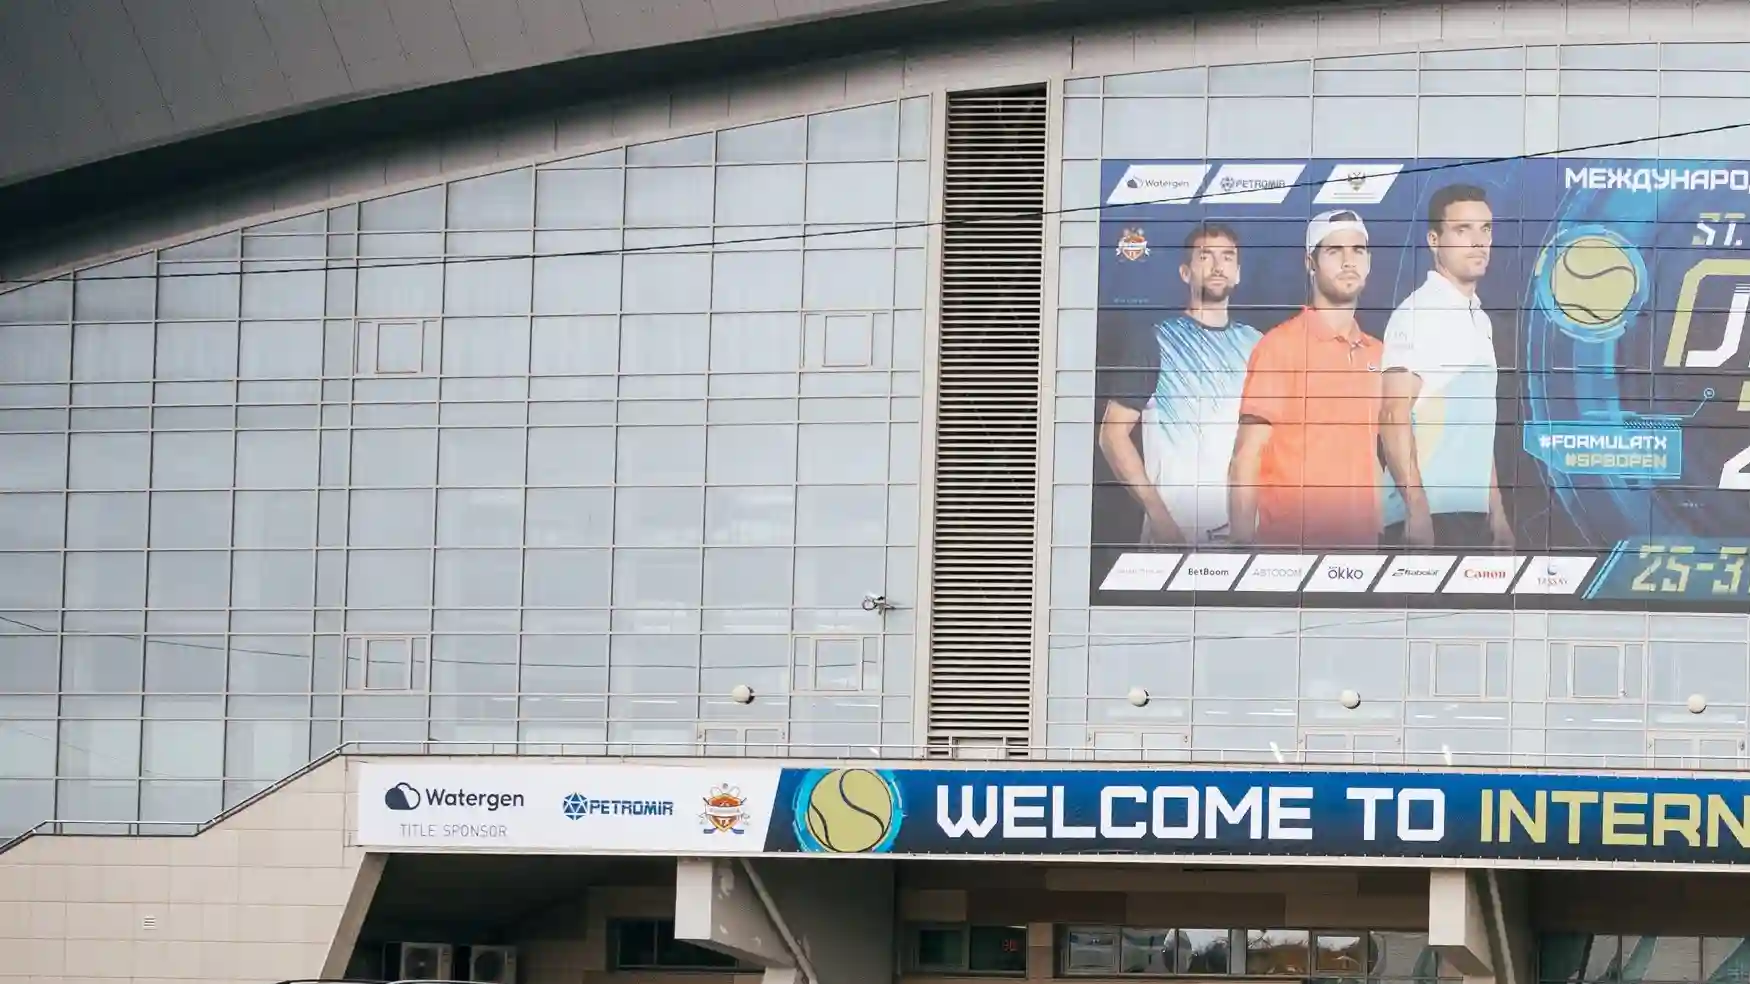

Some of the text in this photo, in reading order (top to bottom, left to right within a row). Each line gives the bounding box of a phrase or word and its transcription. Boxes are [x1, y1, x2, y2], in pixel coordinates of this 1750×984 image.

[1144, 179, 1190, 190] Watergen
[1691, 212, 1744, 247] ST.
[1539, 436, 1668, 452] #FORMULATX
[1564, 453, 1668, 470] #SPBOPEN
[1187, 567, 1229, 577] BetBoom
[1463, 569, 1506, 580] Canon
[425, 788, 525, 812] Watergen
[589, 798, 674, 817] PETROMIR
[936, 785, 1314, 840] WELCOME
[1346, 787, 1447, 841] TO
[399, 823, 508, 838] TITLE SPONSOR
